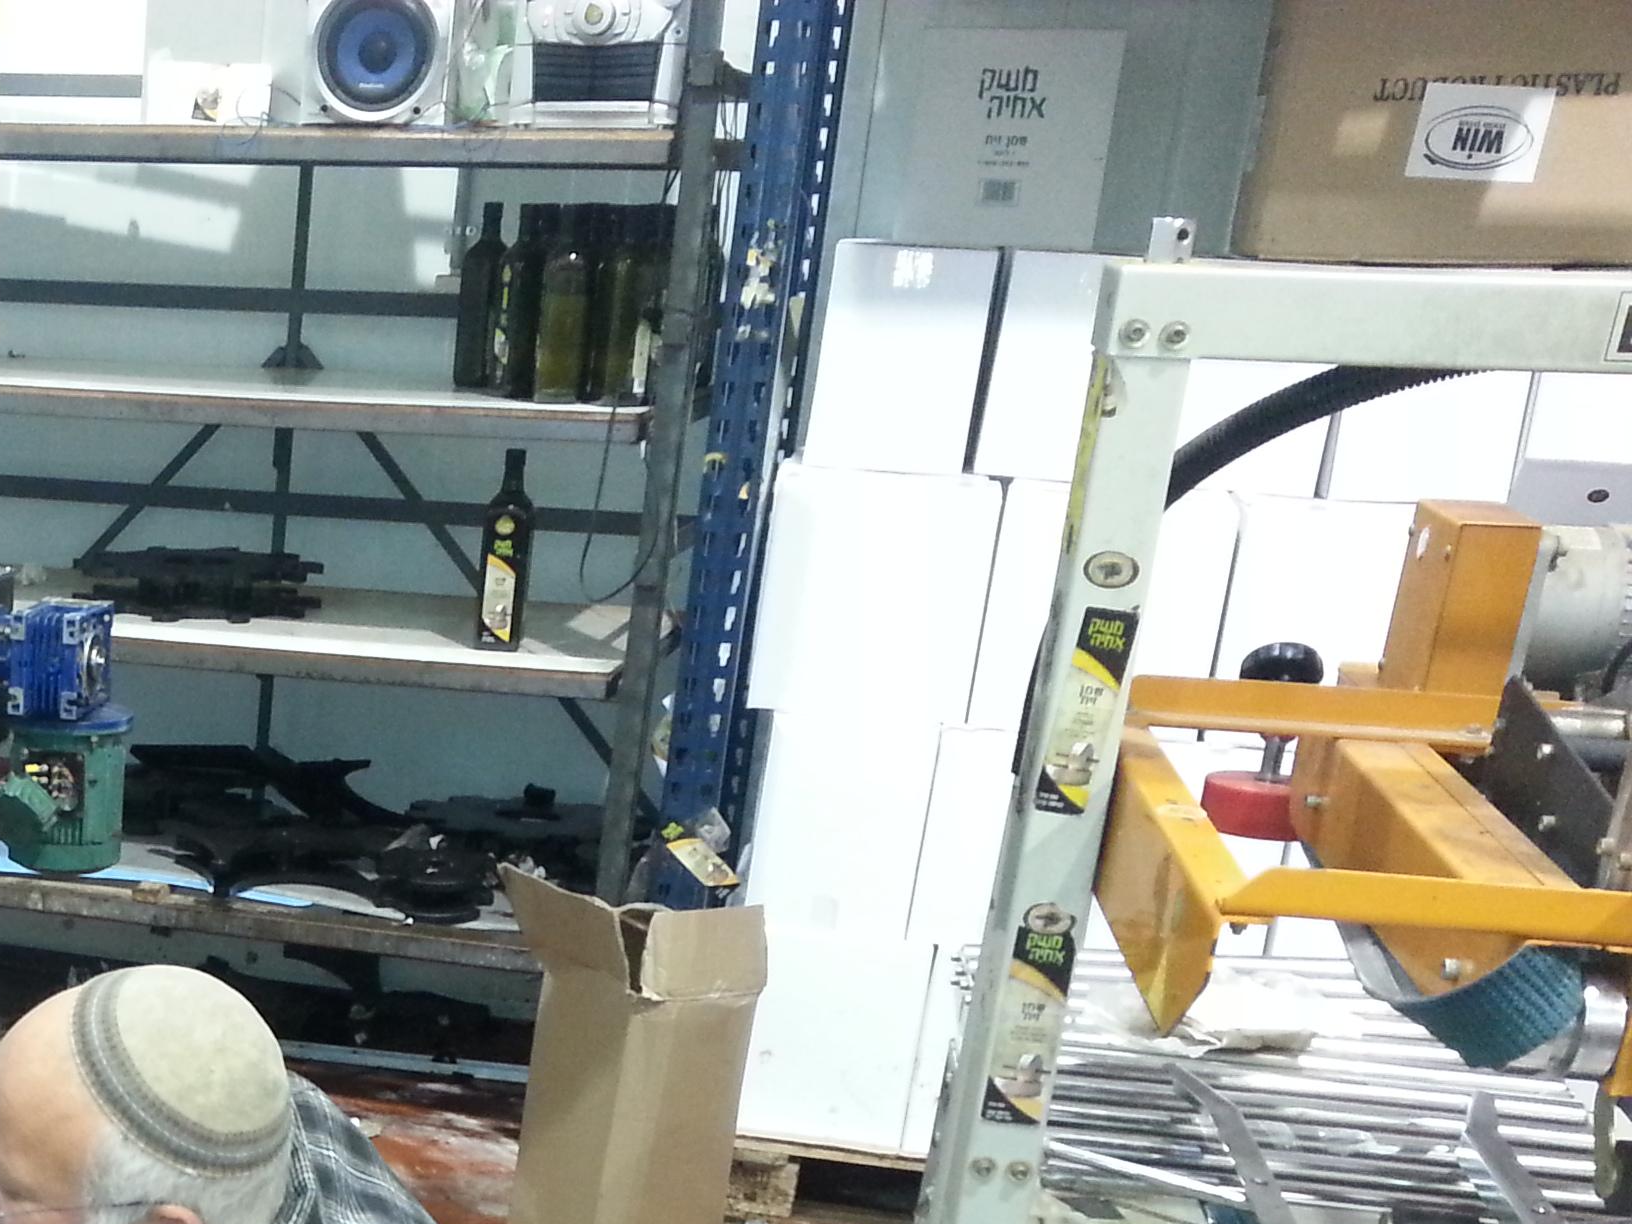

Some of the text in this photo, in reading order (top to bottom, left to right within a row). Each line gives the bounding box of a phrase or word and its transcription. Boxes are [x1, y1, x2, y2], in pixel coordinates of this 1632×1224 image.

[978, 66, 1039, 99] משק
[987, 95, 1046, 119] אחיה
[1088, 616, 1124, 637] משק
[1090, 633, 1126, 651] אחיה
[1025, 932, 1063, 951] משק
[1028, 947, 1065, 966] אחיה
